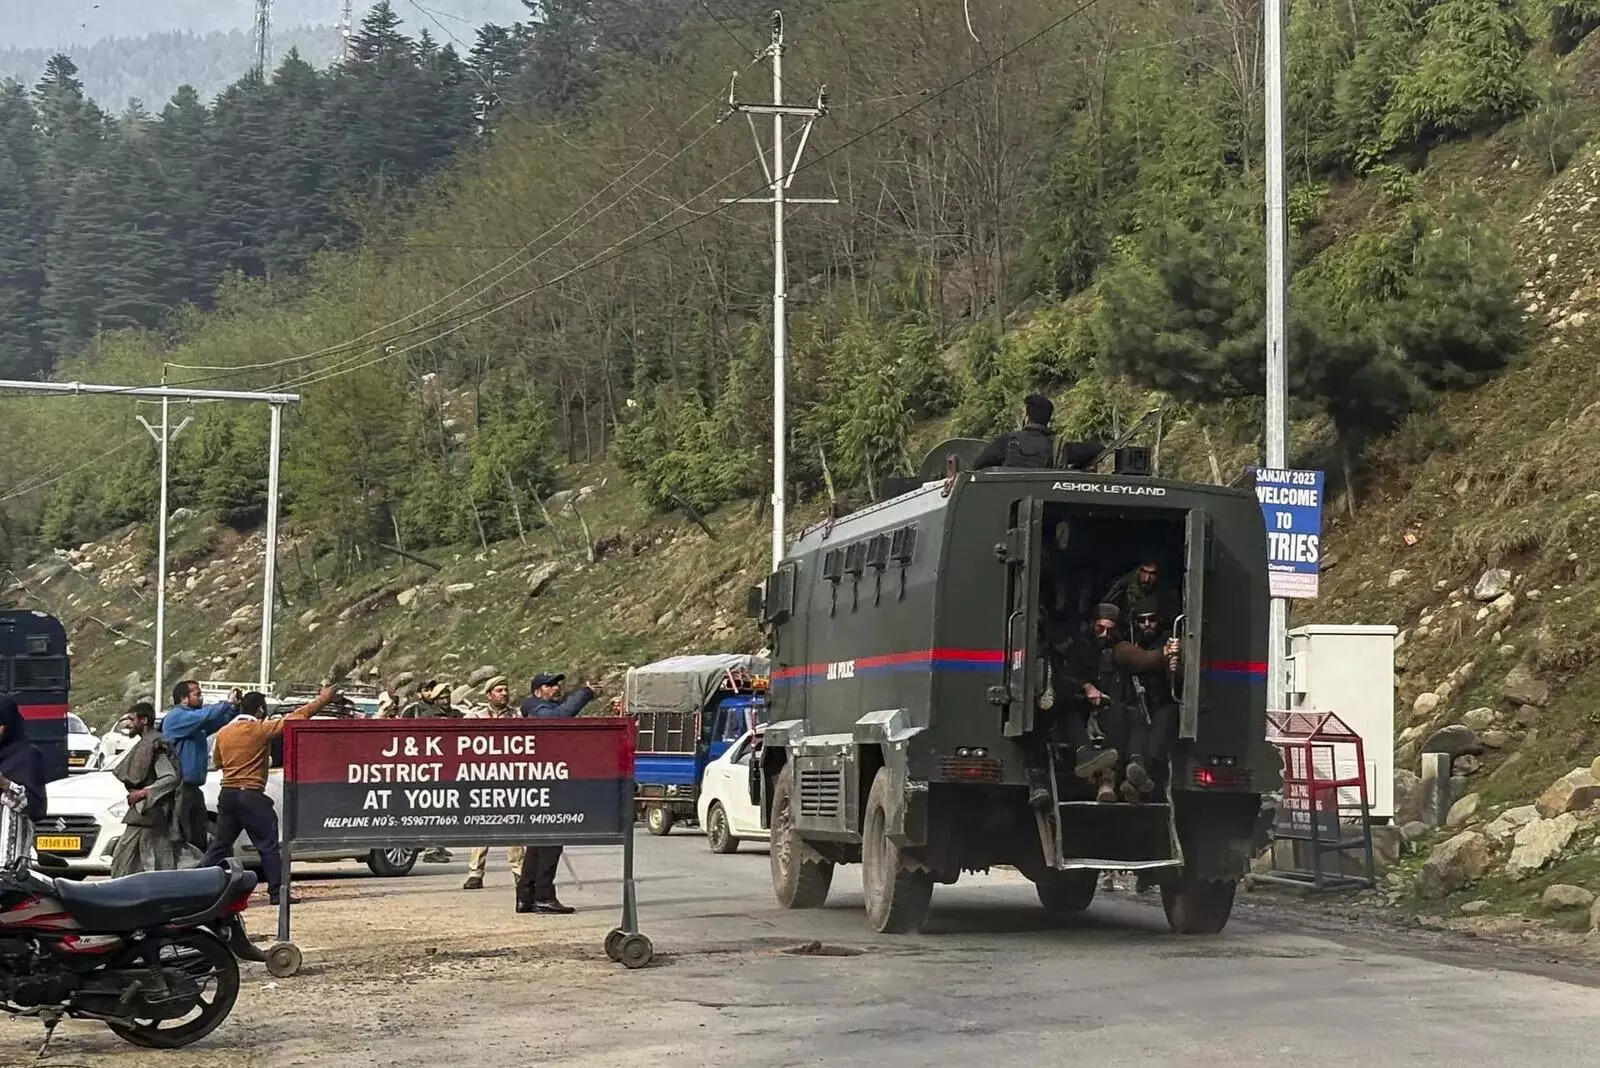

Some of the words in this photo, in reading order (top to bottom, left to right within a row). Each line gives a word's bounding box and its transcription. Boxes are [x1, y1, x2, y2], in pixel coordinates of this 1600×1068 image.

[1256, 469, 1290, 484] SANJAY
[1293, 472, 1316, 485] 2023
[1052, 481, 1101, 493] ASHOK
[1103, 484, 1166, 496] LEYLAND
[1255, 486, 1318, 507] WELCOME
[1276, 511, 1293, 529] TO
[457, 735, 536, 755] POLICE
[348, 763, 443, 784] DISTRICT
[456, 761, 569, 782] ANANTNAG
[363, 790, 392, 810] AT
[405, 789, 460, 809] YOUR
[470, 787, 551, 808] SERVICE
[323, 816, 369, 828] HELPLINE
[529, 813, 585, 824] 9419051940
